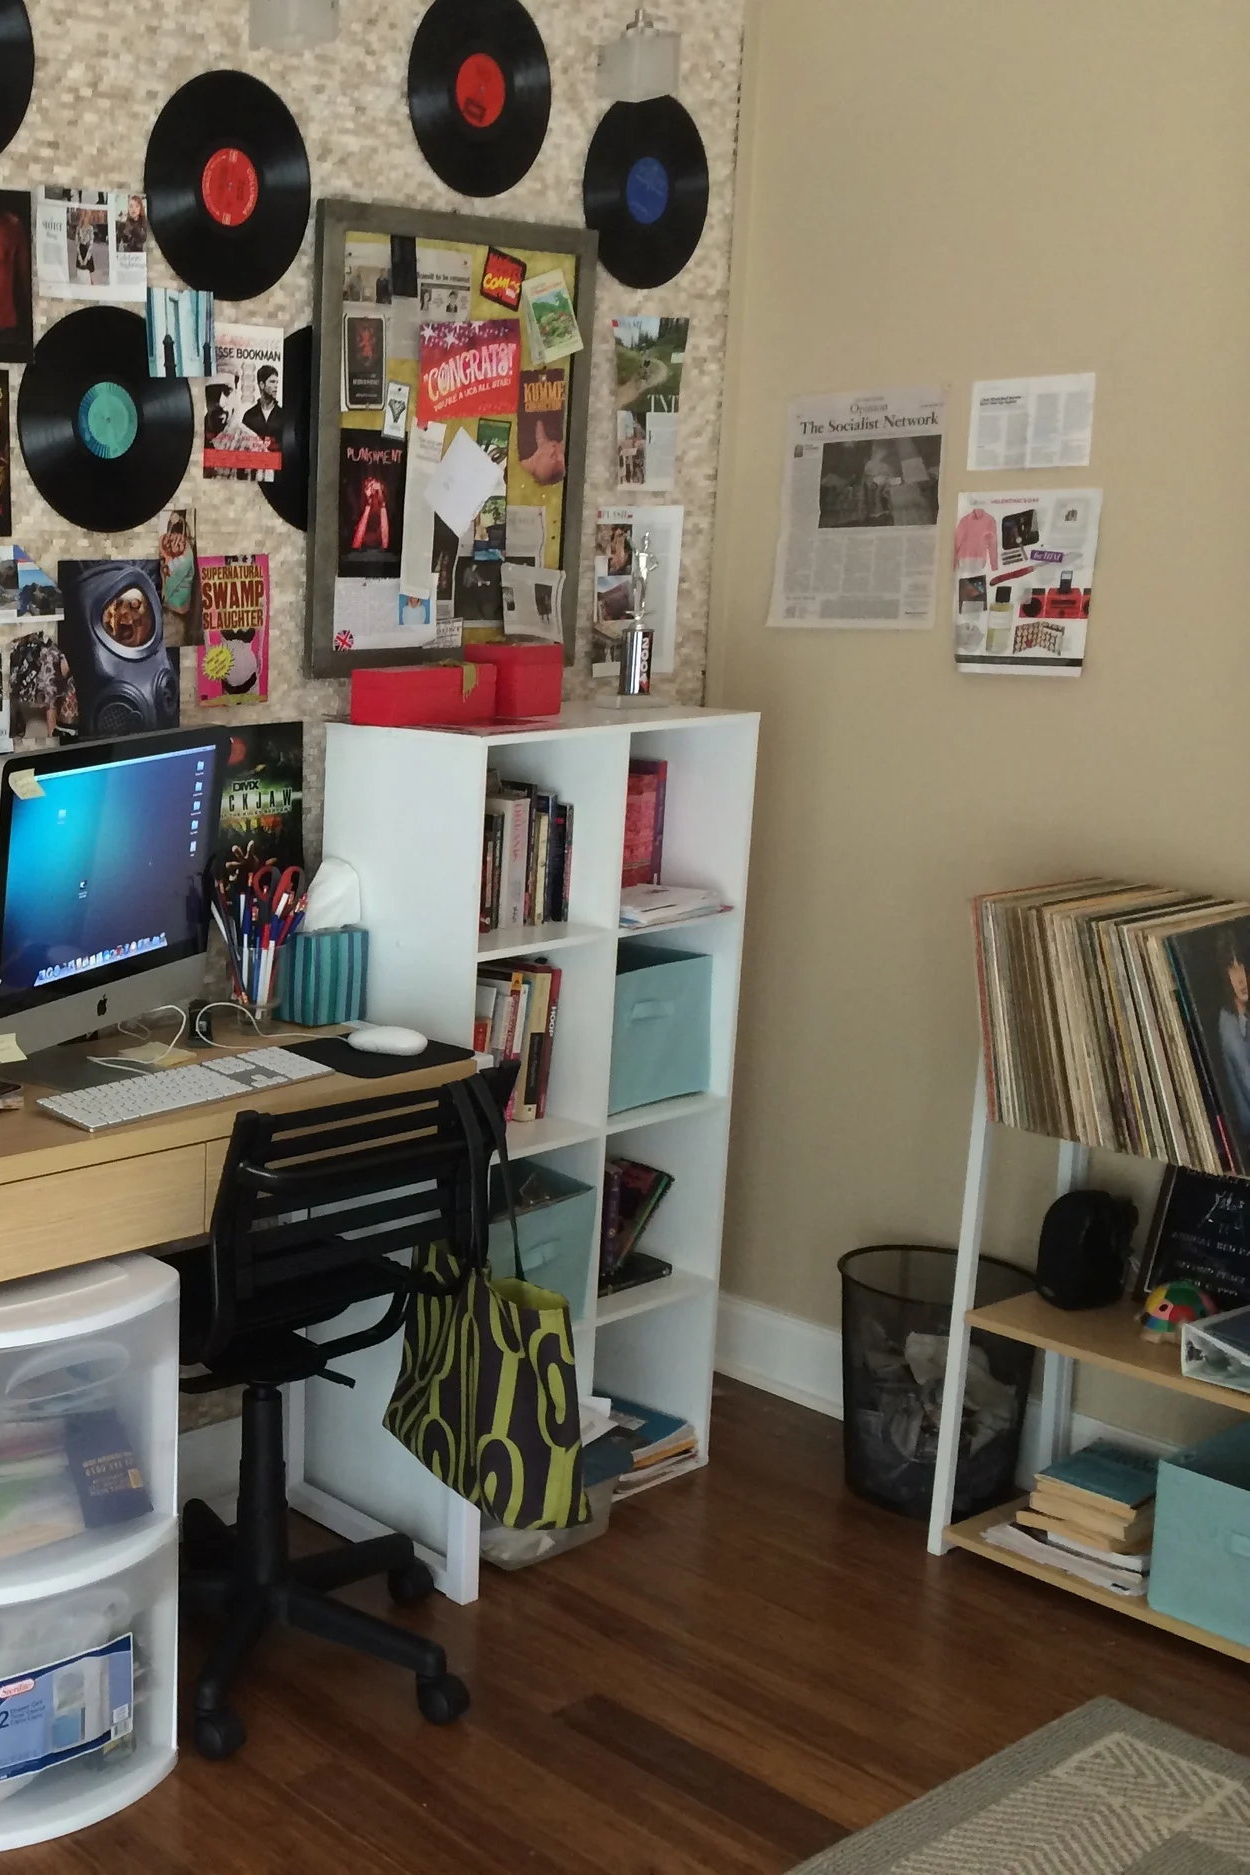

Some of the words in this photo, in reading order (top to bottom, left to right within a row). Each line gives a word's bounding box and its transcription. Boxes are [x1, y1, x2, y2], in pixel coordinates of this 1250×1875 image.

[236, 348, 281, 361] BOOKMAN
[428, 342, 517, 401] CONGRATS!
[850, 402, 888, 416] Opinion
[800, 420, 824, 434] The
[828, 417, 880, 433] Socialist
[884, 411, 940, 429] Network
[202, 565, 264, 581] SUPERNATURAL
[202, 580, 265, 610] SWAMP
[203, 609, 264, 630] SLAUGHTER
[233, 780, 259, 792] DMX
